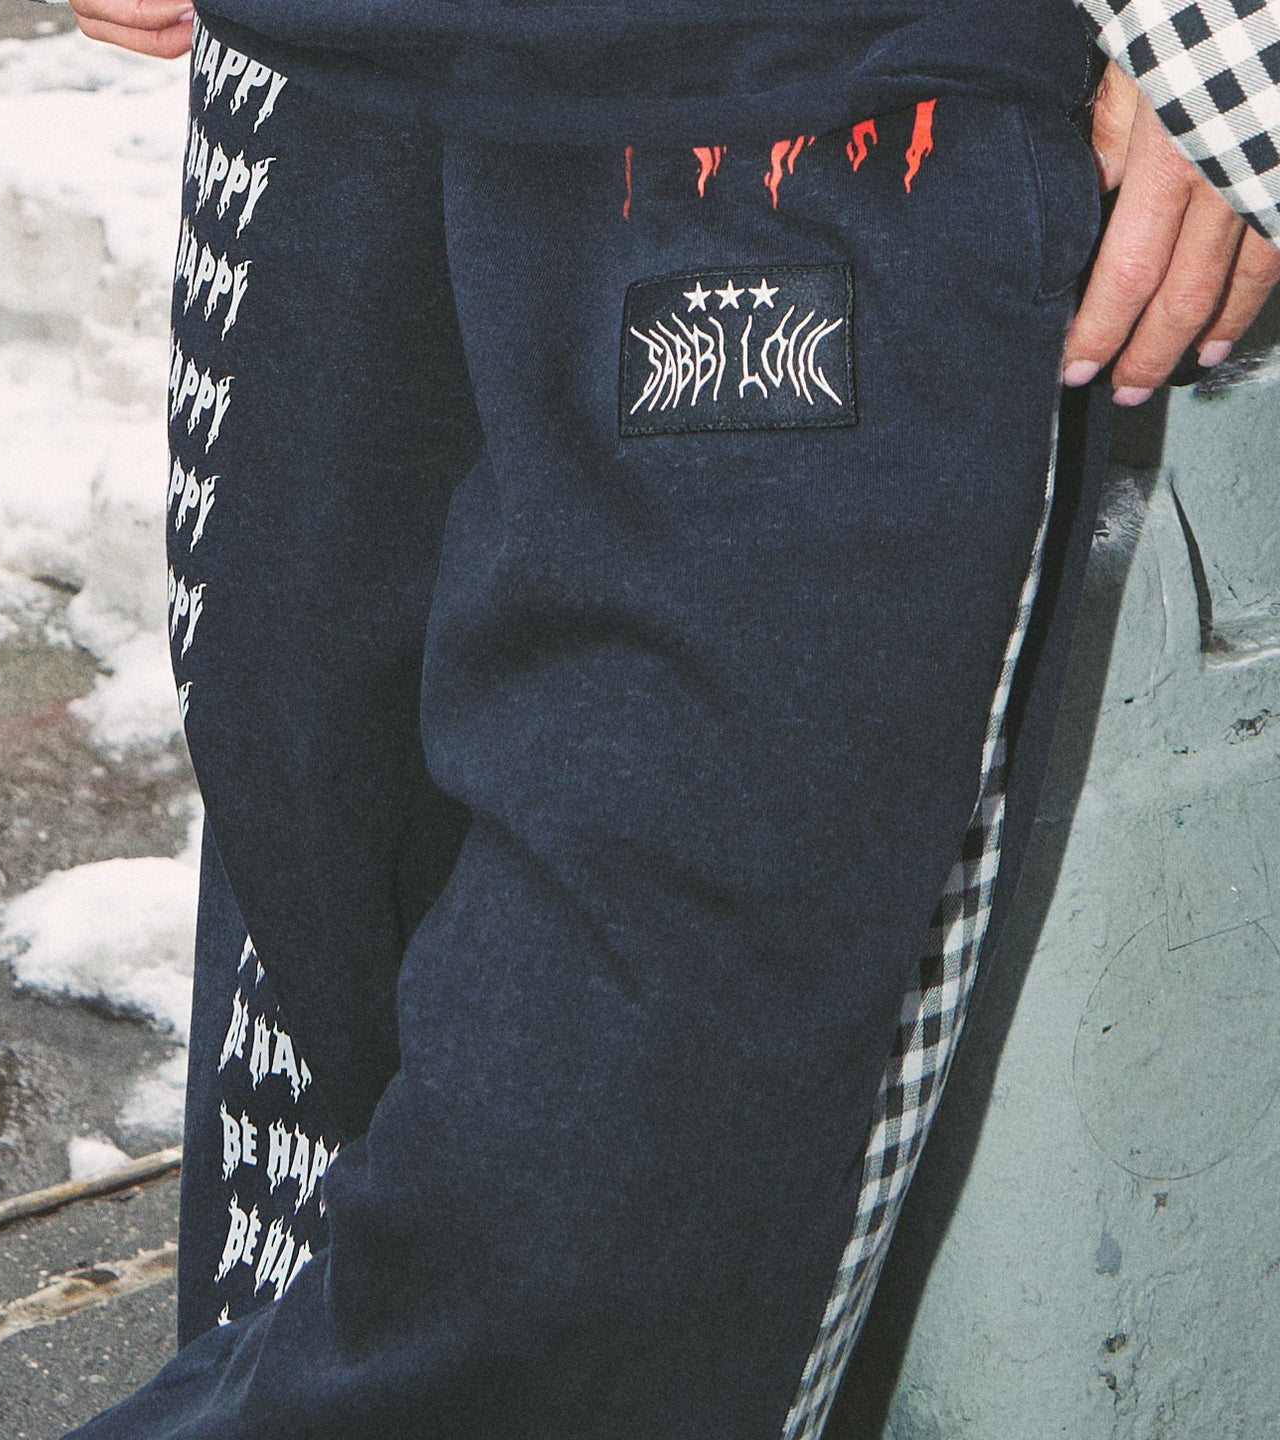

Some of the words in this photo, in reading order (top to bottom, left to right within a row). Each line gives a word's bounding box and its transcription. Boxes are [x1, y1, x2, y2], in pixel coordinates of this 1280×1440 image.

[217, 985, 249, 1074] BE
[220, 1099, 258, 1182] BE
[214, 1189, 262, 1284] BE
